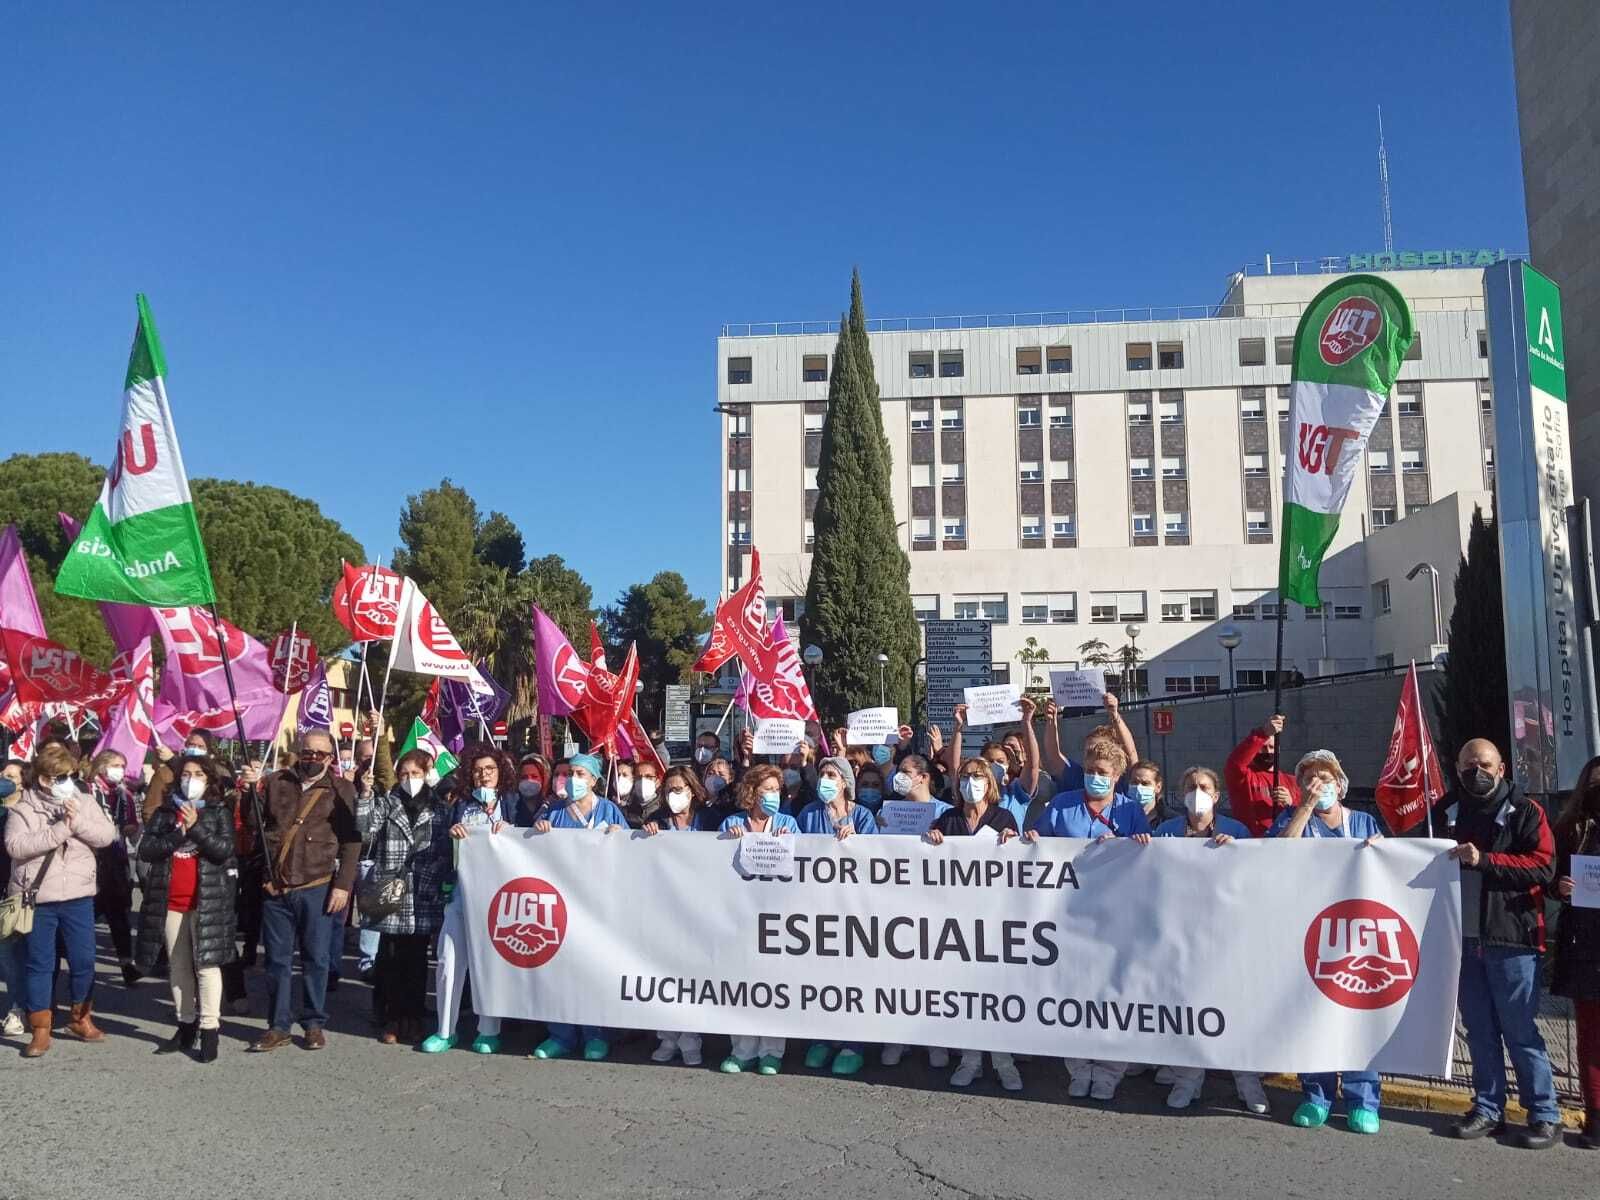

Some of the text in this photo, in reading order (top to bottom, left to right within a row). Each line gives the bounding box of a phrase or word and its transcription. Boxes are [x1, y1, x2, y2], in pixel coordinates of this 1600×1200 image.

[1328, 308, 1377, 336] UGT
[1298, 422, 1361, 476] UGT
[1543, 404, 1573, 737] Hospital Universitario
[31, 646, 77, 673] UGT
[928, 665, 966, 673] mortuario
[869, 858, 911, 886] DE
[922, 858, 1080, 890] LIMPIEZA
[496, 891, 558, 931] UGT
[758, 912, 1060, 967] ESENCIALES
[1318, 917, 1403, 962] UGT
[620, 975, 1226, 1038] LUCHAMOS POR NUESTRO CONVENIO
